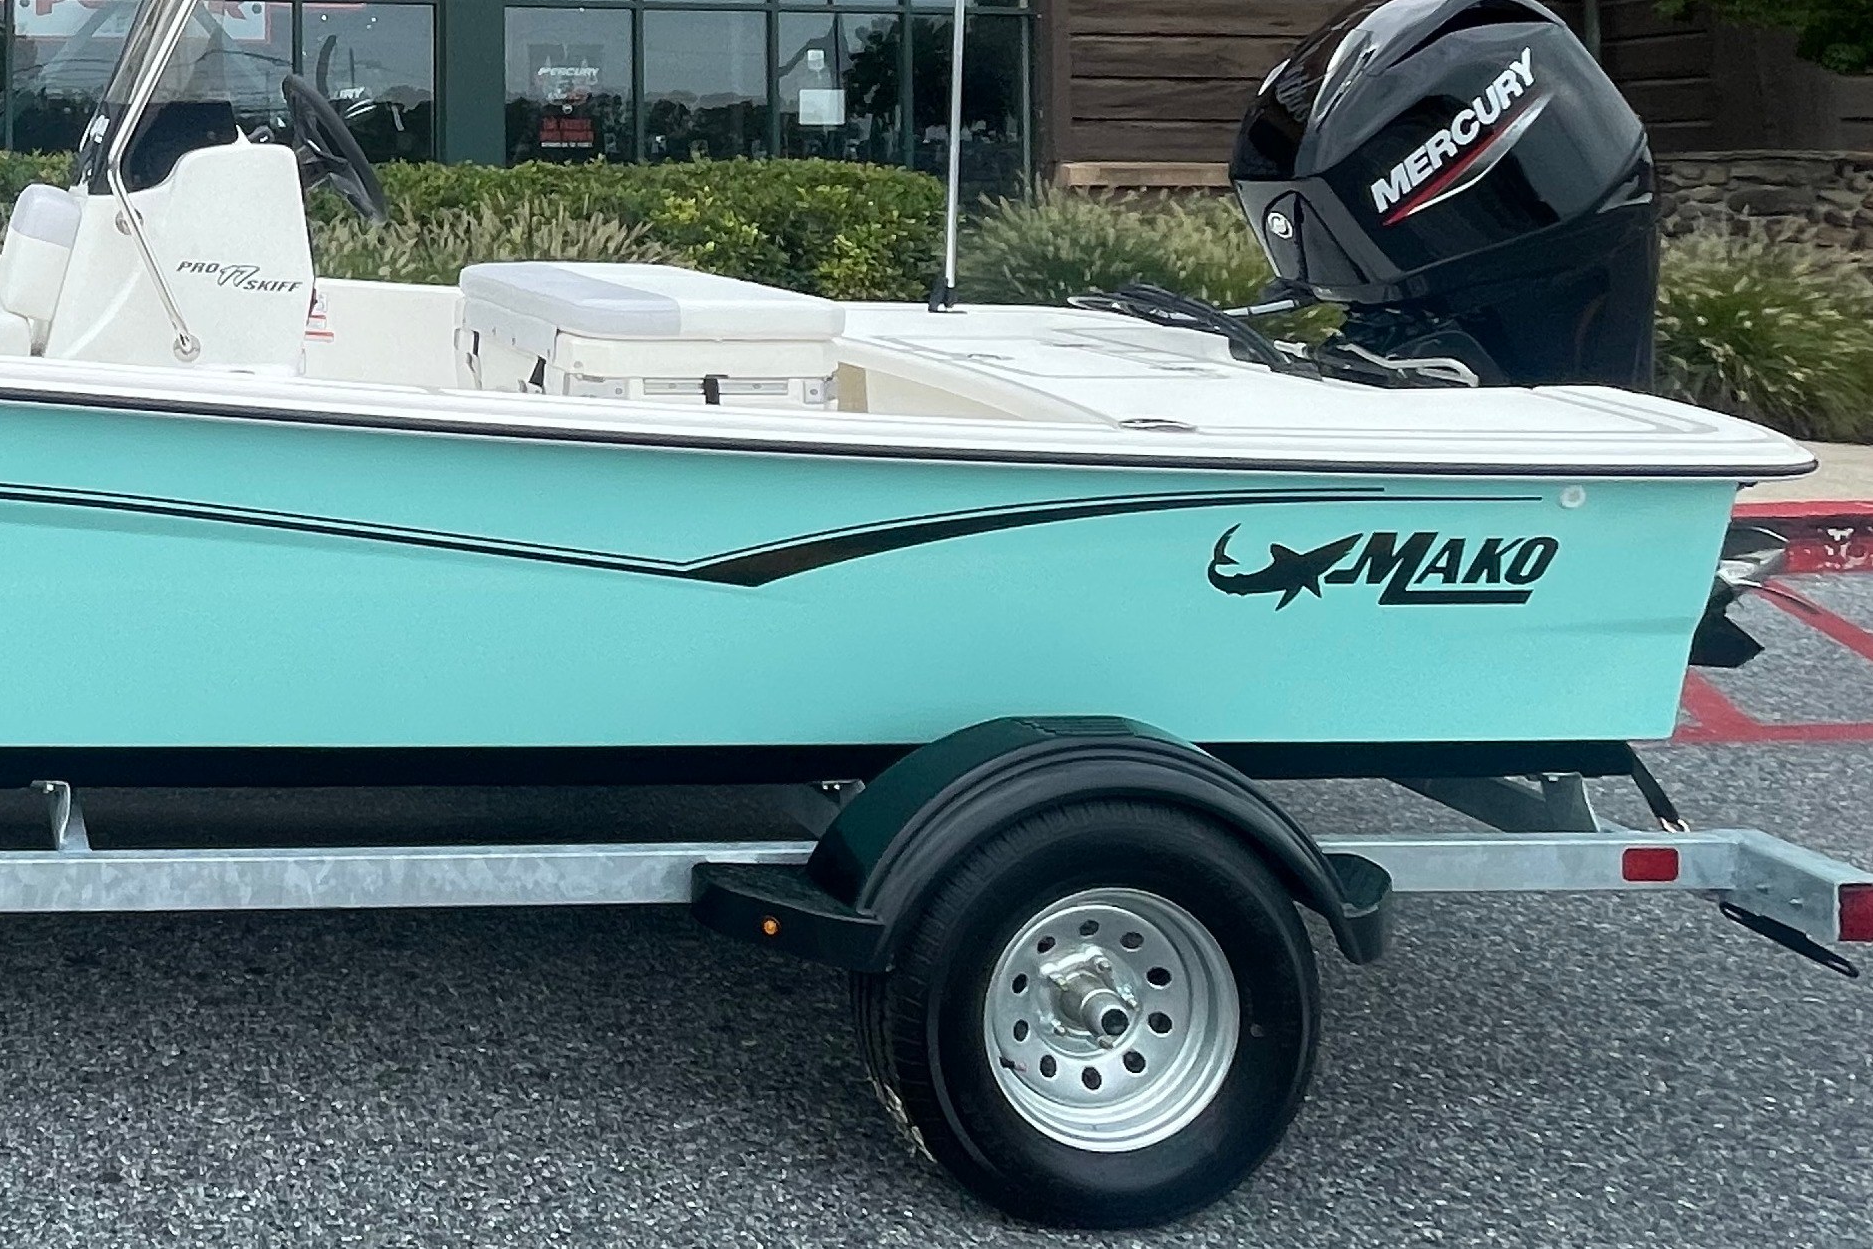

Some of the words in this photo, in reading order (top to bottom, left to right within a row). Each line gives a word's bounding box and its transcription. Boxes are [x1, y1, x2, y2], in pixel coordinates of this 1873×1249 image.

[1369, 47, 1538, 214] MERCURY
[176, 260, 220, 274] PRO
[242, 279, 304, 293] SKIFF
[1324, 531, 1560, 606] MAKO
